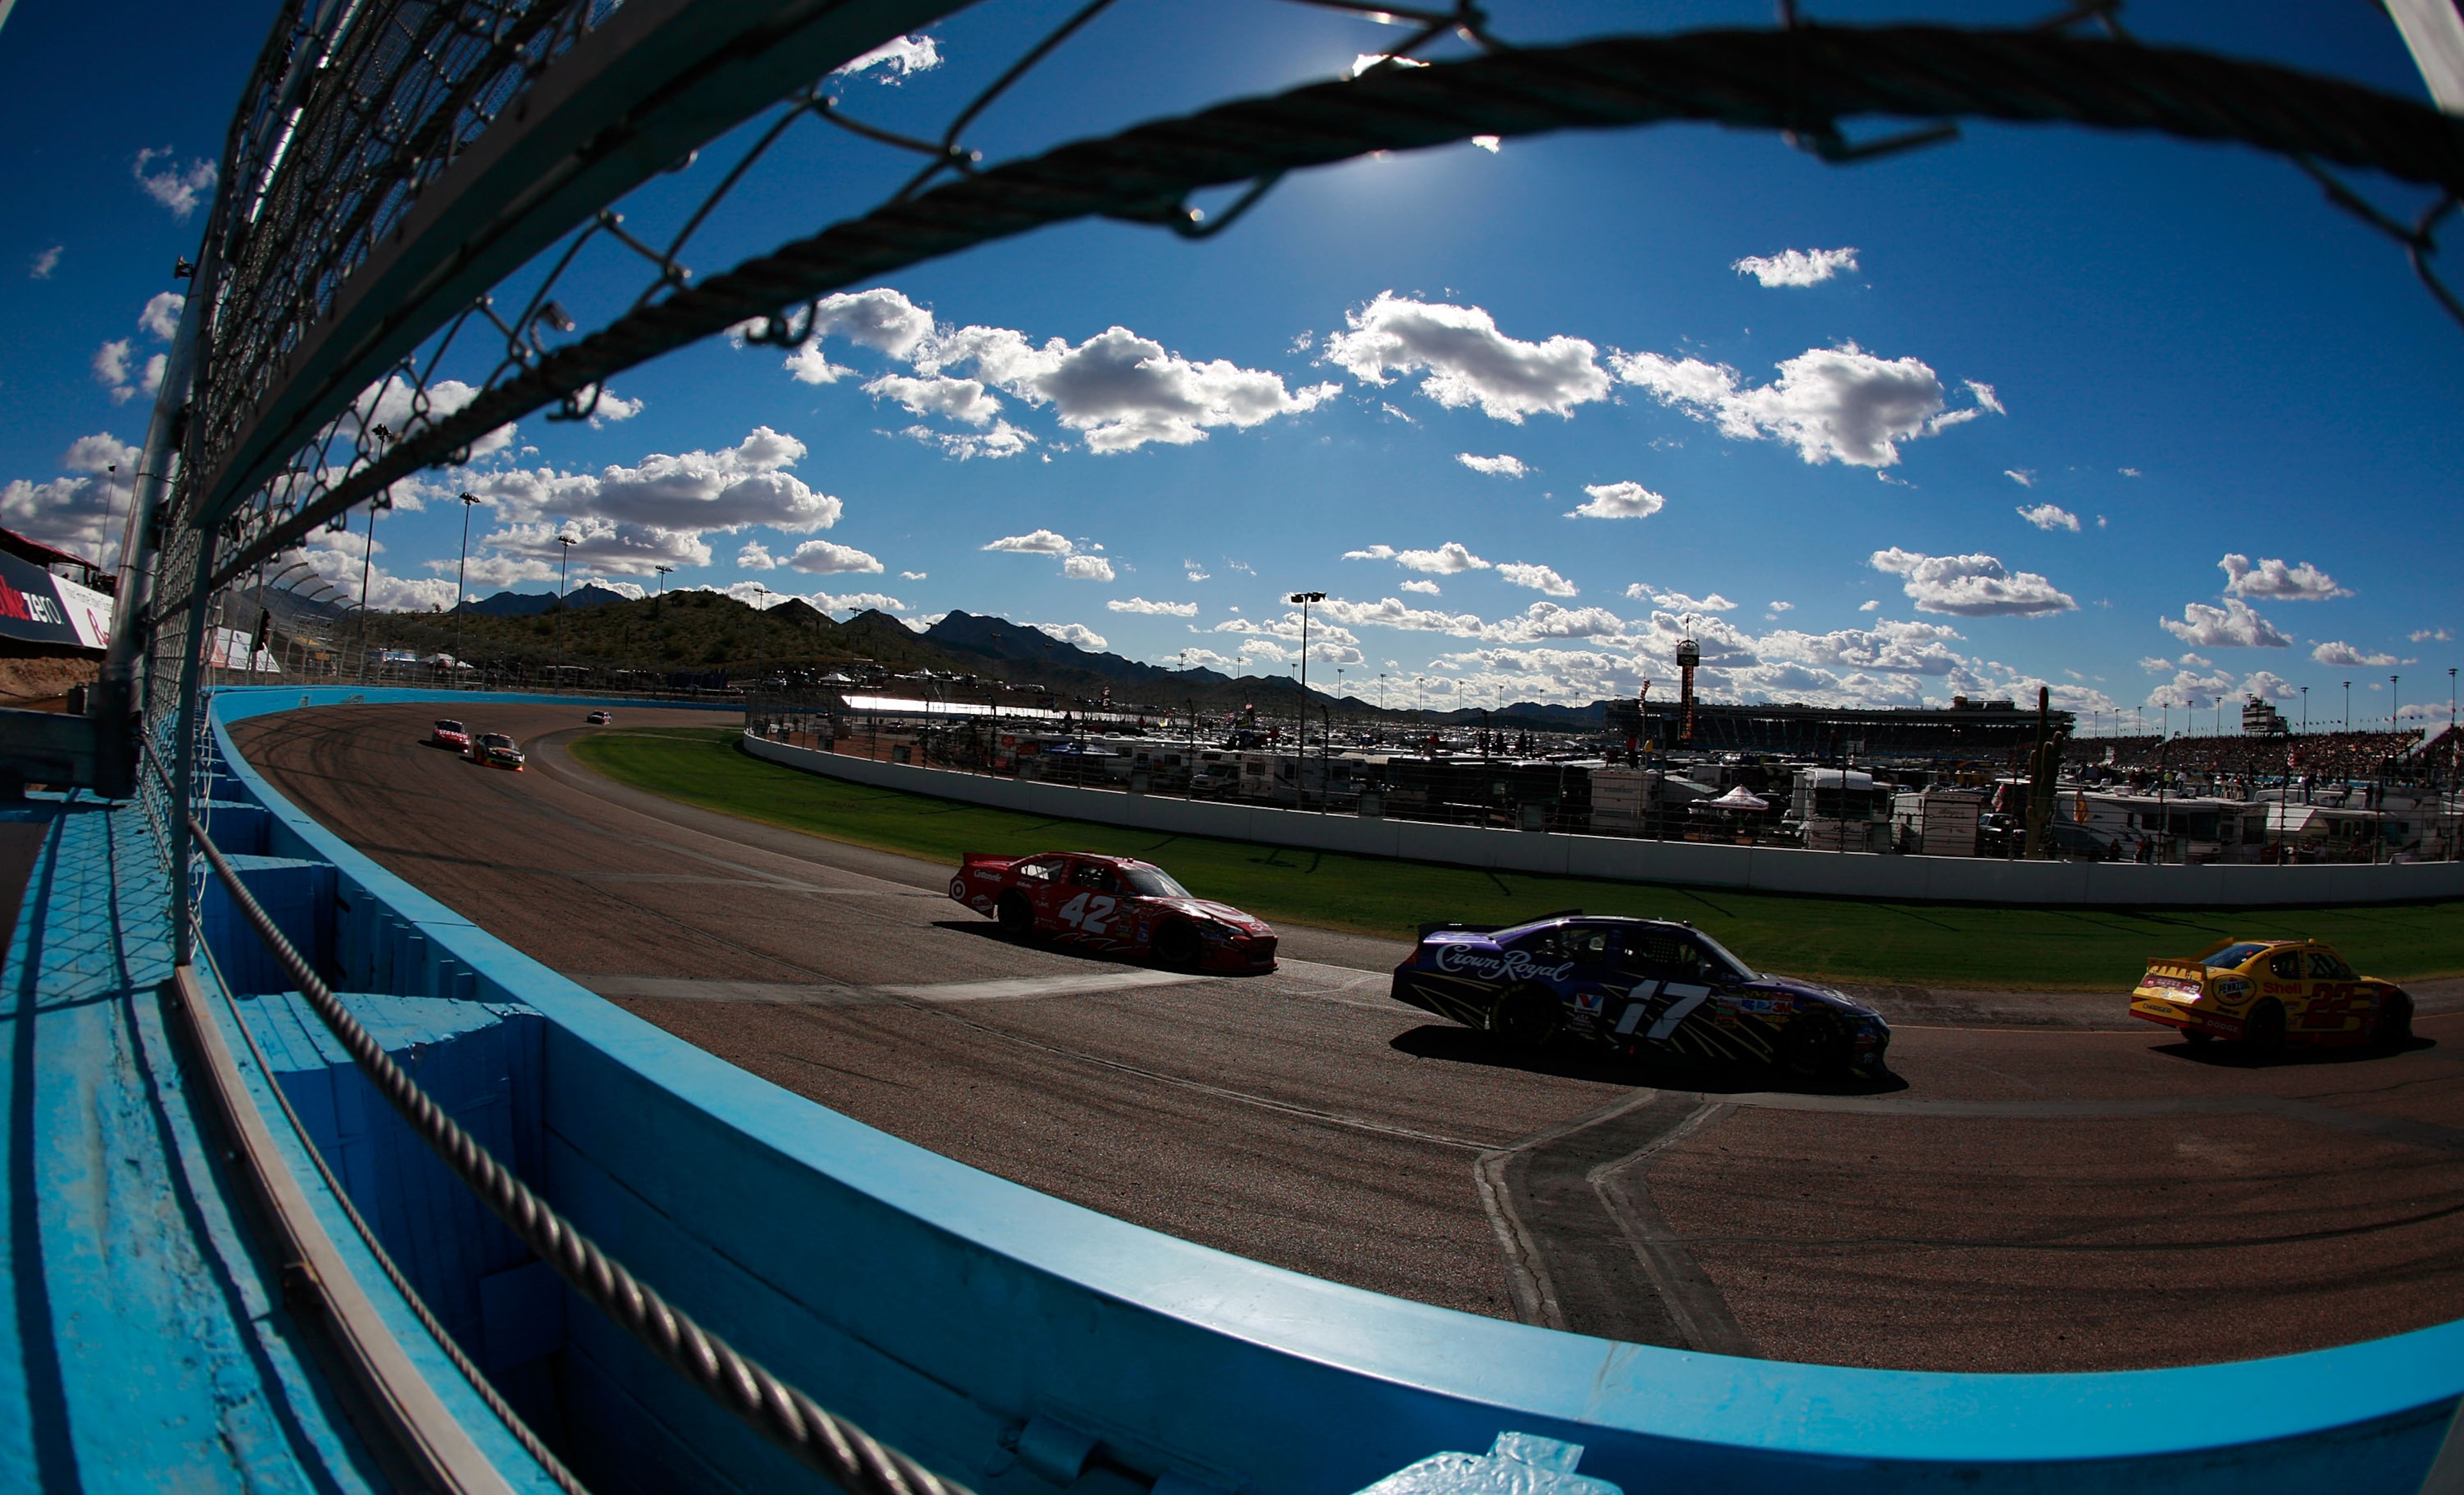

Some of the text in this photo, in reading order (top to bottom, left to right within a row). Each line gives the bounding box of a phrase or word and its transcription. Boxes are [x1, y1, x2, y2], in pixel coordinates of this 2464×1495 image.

[21, 592, 62, 624] zero
[1058, 892, 1116, 935] 42
[1435, 943, 1576, 982] Crown Royal
[2263, 982, 2302, 994] Shell
[1613, 978, 1713, 1040] 17
[1773, 1002, 1792, 1013] 3M
[2143, 1004, 2173, 1014] CHARGER
[2302, 983, 2354, 1029] 22
[2207, 1020, 2239, 1032] DODGE
